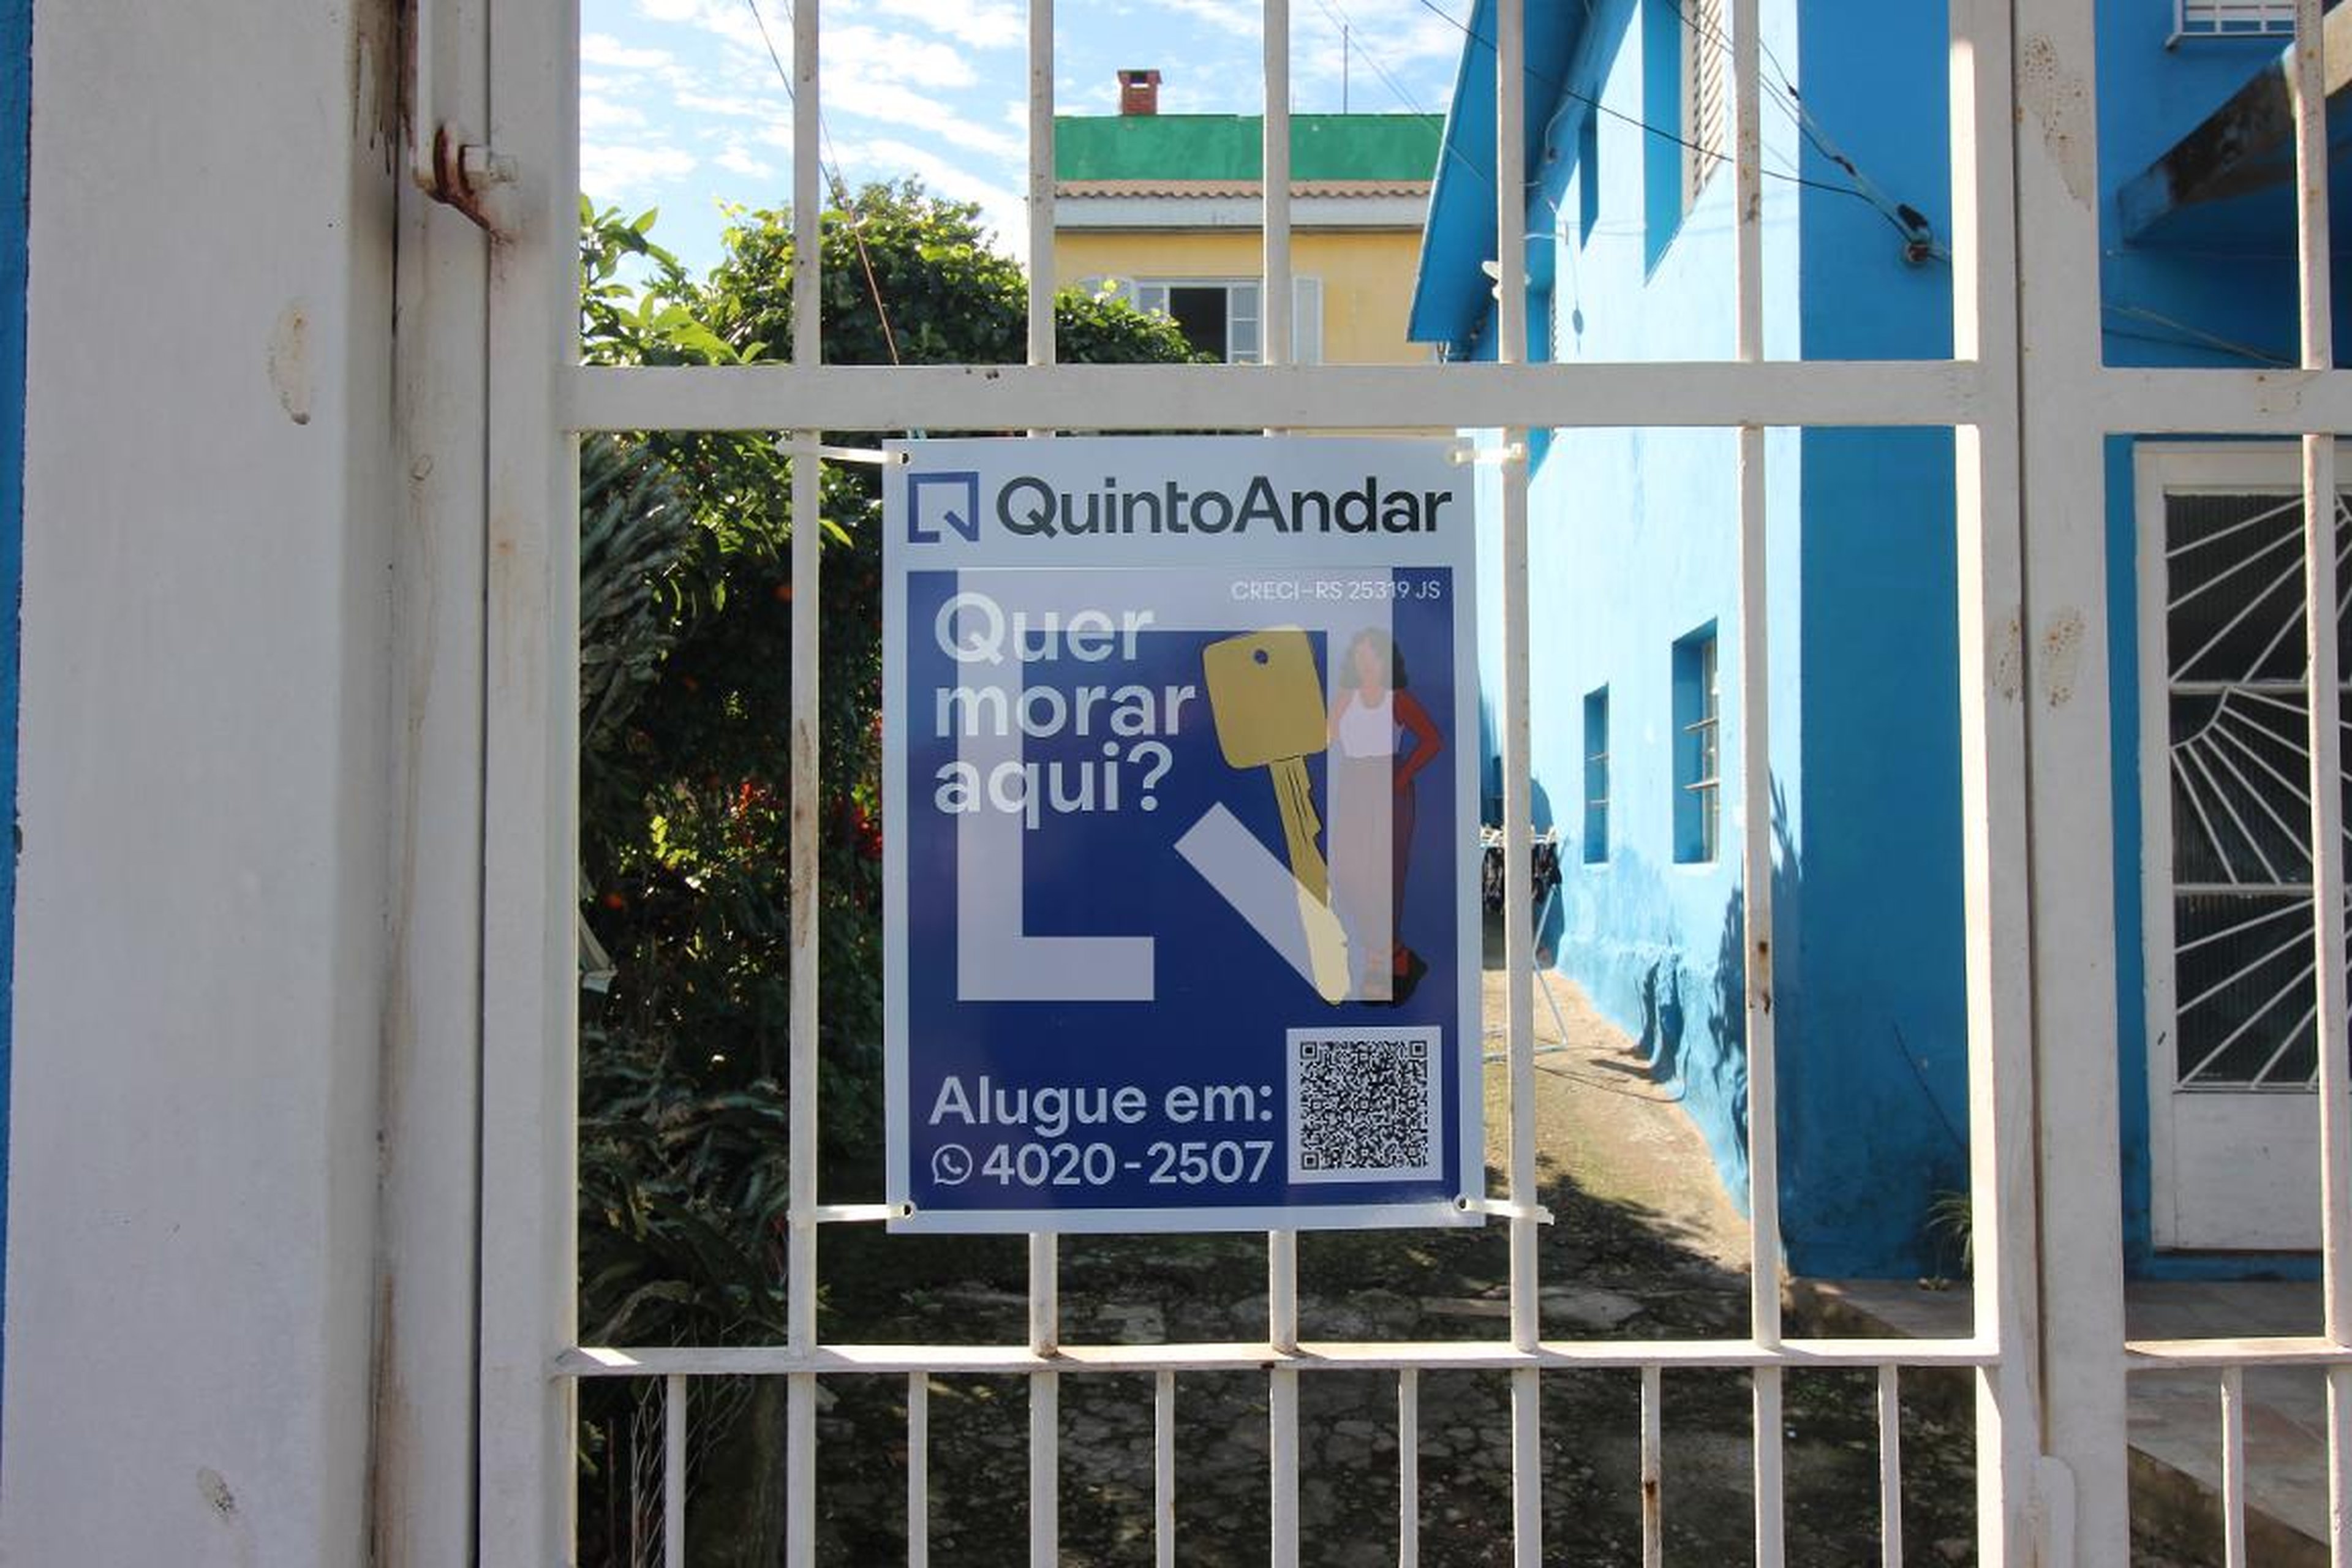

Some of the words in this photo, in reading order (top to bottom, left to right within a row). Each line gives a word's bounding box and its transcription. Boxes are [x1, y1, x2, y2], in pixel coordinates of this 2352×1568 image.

[996, 475, 1453, 539] QuintoAndar
[1348, 580, 1409, 600] 25319
[1415, 579, 1441, 599] JS
[934, 591, 1155, 665] Quer
[935, 682, 1196, 737] morar
[934, 740, 1173, 831] aqui?
[929, 1075, 1146, 1137] Alugue
[1165, 1084, 1274, 1123] em:
